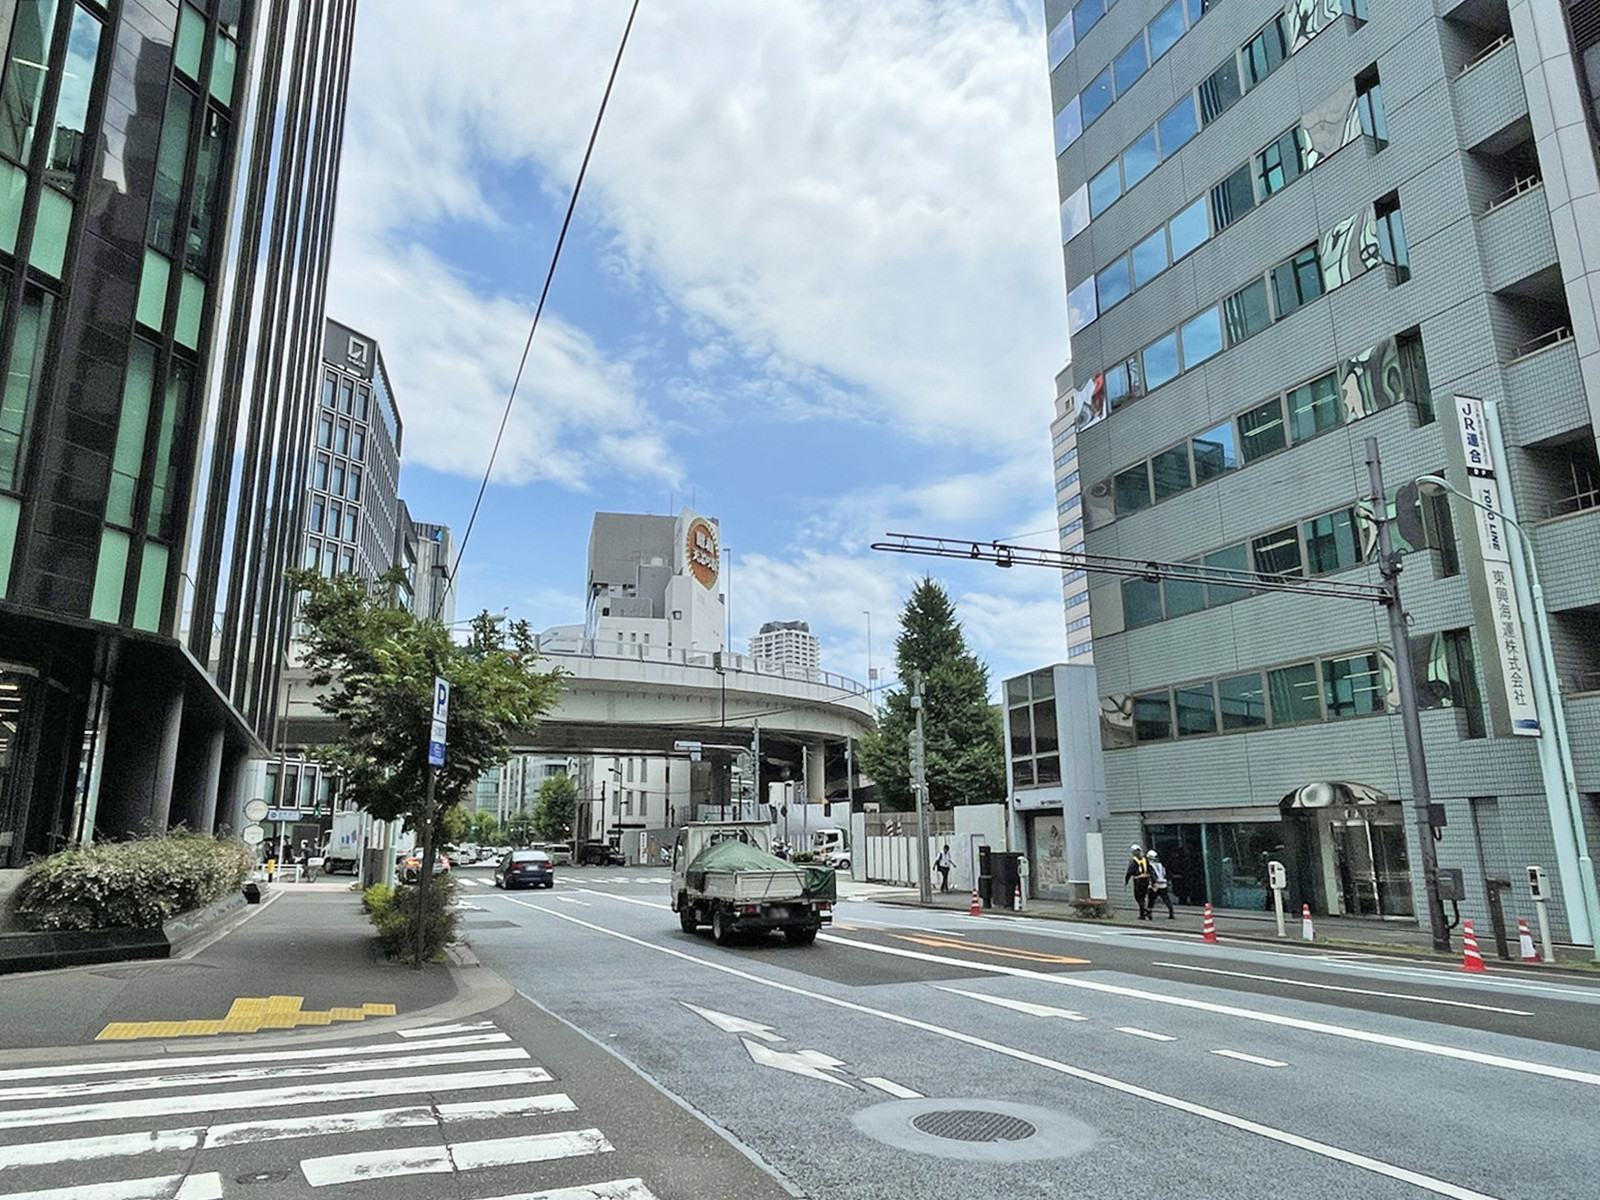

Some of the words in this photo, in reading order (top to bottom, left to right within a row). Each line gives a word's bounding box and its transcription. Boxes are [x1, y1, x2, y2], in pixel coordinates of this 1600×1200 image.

[1462, 403, 1481, 464] JR連合
[1489, 524, 1501, 551] LINE
[437, 684, 447, 715] P
